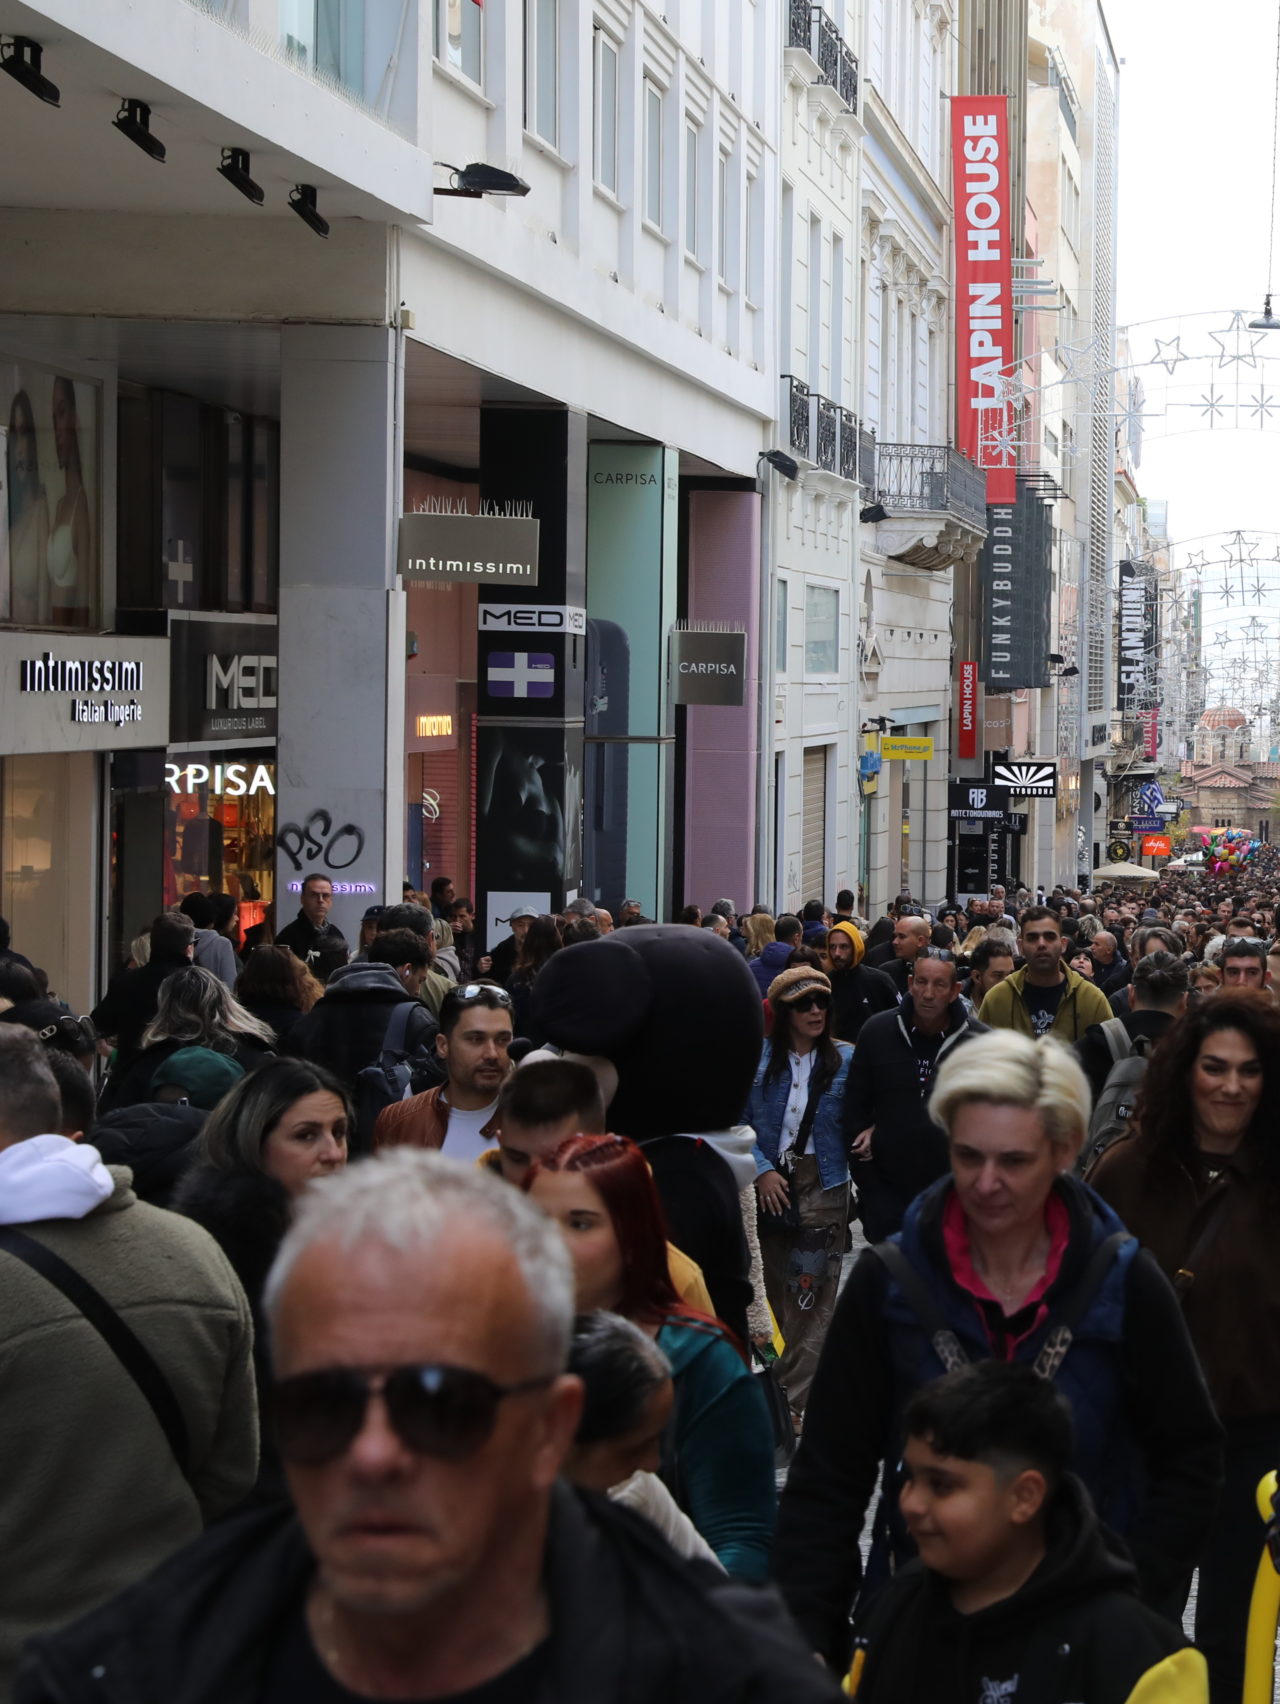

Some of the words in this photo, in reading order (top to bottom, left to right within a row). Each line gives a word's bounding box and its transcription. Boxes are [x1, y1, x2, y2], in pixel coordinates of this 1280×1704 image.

[963, 114, 1001, 261] HOUSE
[968, 283, 1003, 409] LAPIN
[593, 472, 658, 486] CARPISA
[408, 556, 532, 576] intimissimi
[482, 608, 564, 627] MED
[26, 652, 143, 692] intimissimi
[678, 662, 737, 675] CARPISA
[962, 664, 973, 698] HOUSE
[75, 700, 104, 722] Italian
[108, 700, 142, 727] lingerie
[211, 718, 246, 730] LUXURIOUS
[248, 717, 266, 729] LABEL
[962, 699, 973, 731] LAPIN
